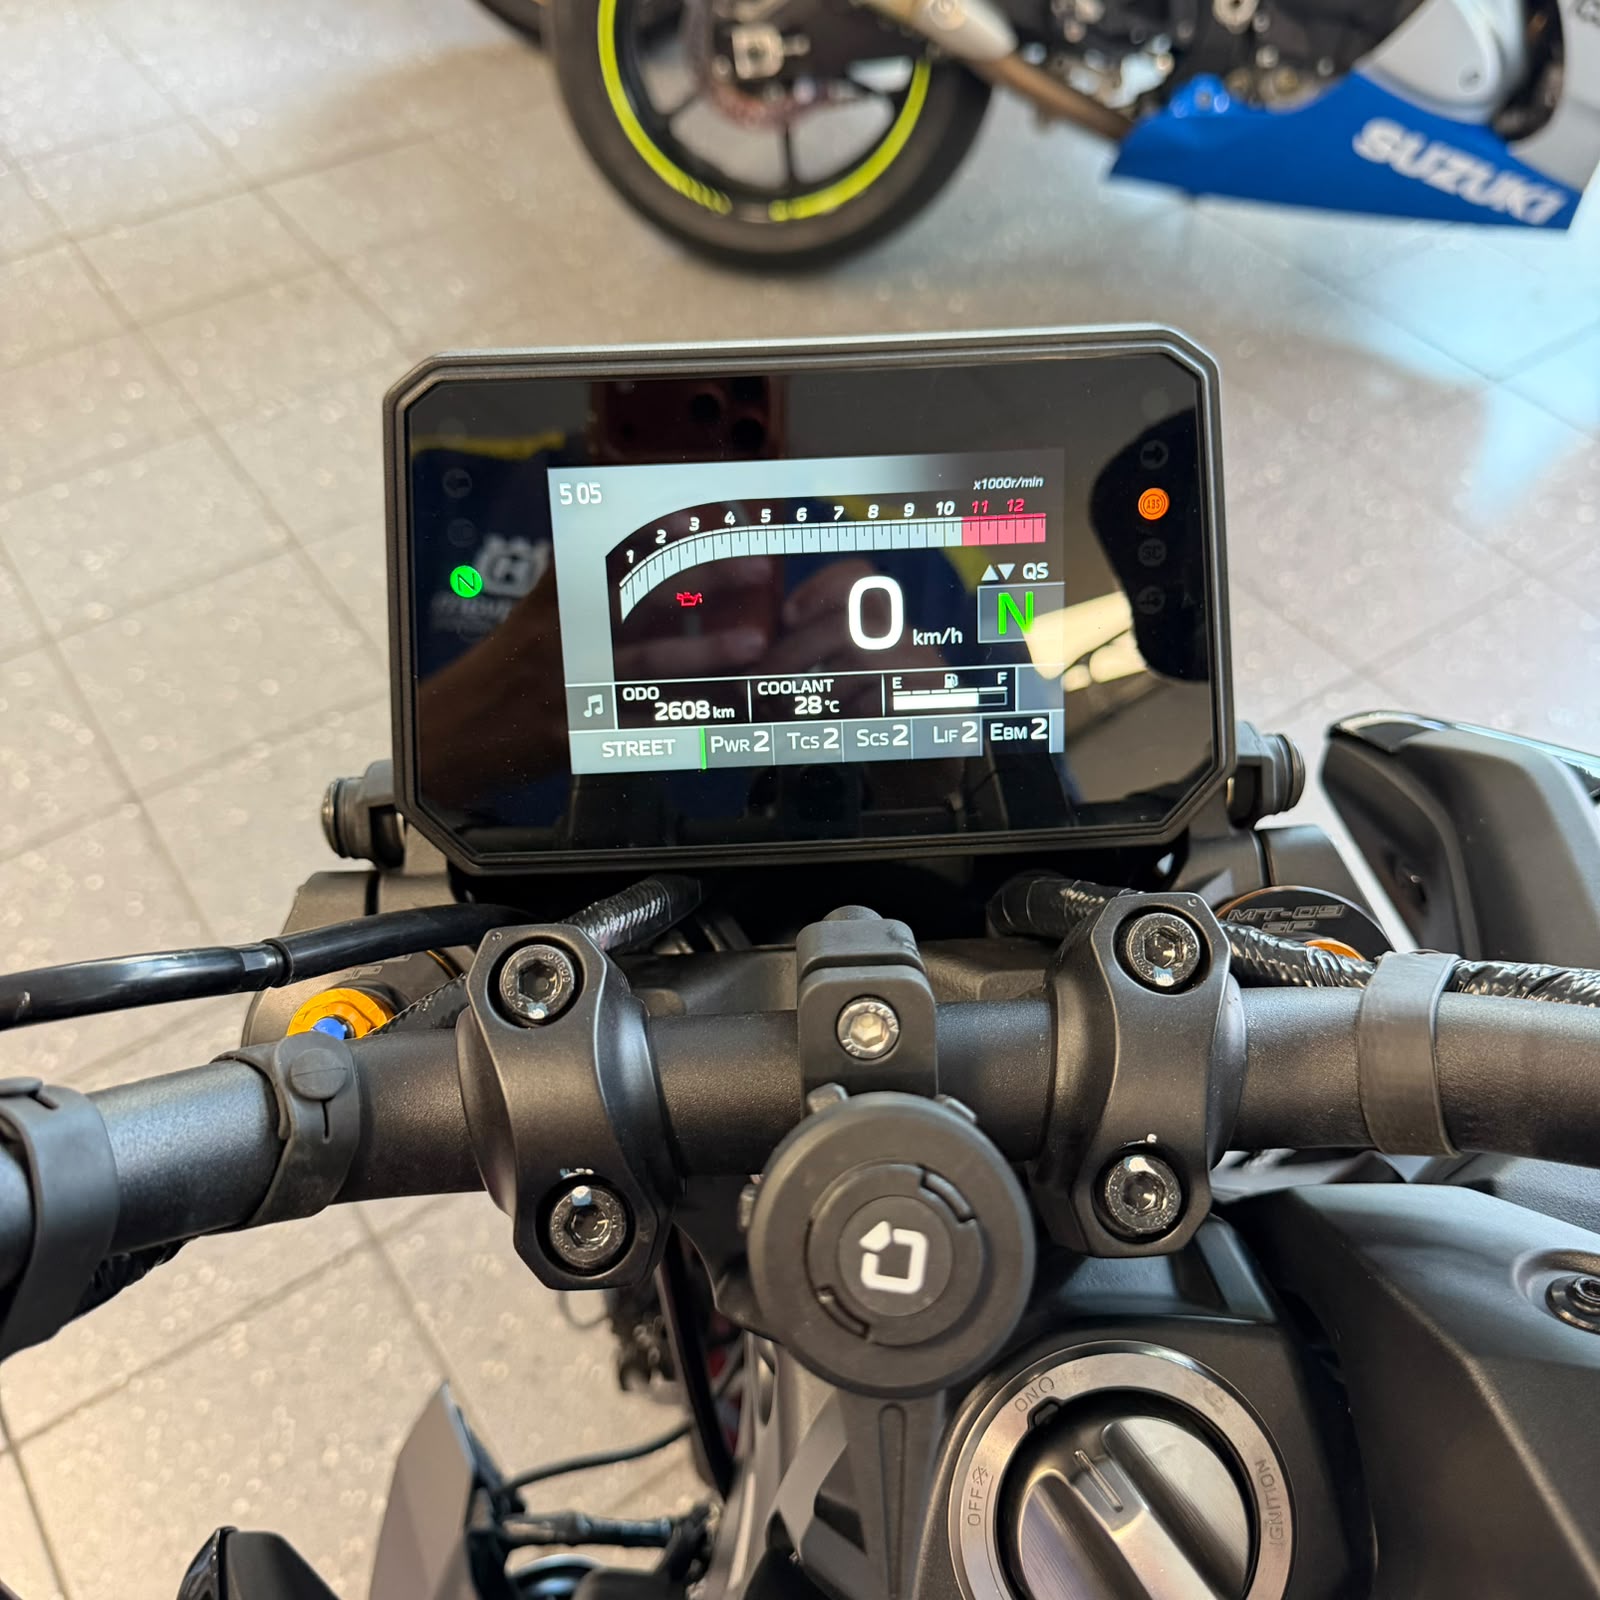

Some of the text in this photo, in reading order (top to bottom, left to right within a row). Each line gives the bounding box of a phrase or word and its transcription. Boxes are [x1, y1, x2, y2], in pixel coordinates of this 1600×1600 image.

[1351, 117, 1567, 225] SUZUKI
[626, 498, 1025, 564] 1 2 3 4 5 6 7 8 9 10 11 12
[1022, 562, 1049, 580] QS
[848, 575, 963, 650] 0 km/h
[998, 591, 1034, 635] N
[757, 678, 834, 695] COOLANT
[892, 677, 902, 689] E
[997, 672, 1007, 685] F
[622, 686, 660, 701] ODO
[654, 700, 735, 721] 2608 km
[602, 738, 676, 758] STREET
[1227, 904, 1346, 922] MT-09
[1261, 920, 1319, 934] SP
[1014, 1386, 1039, 1413] ON
[967, 1486, 984, 1527] OFF
[1254, 1459, 1287, 1546] IGNITION
